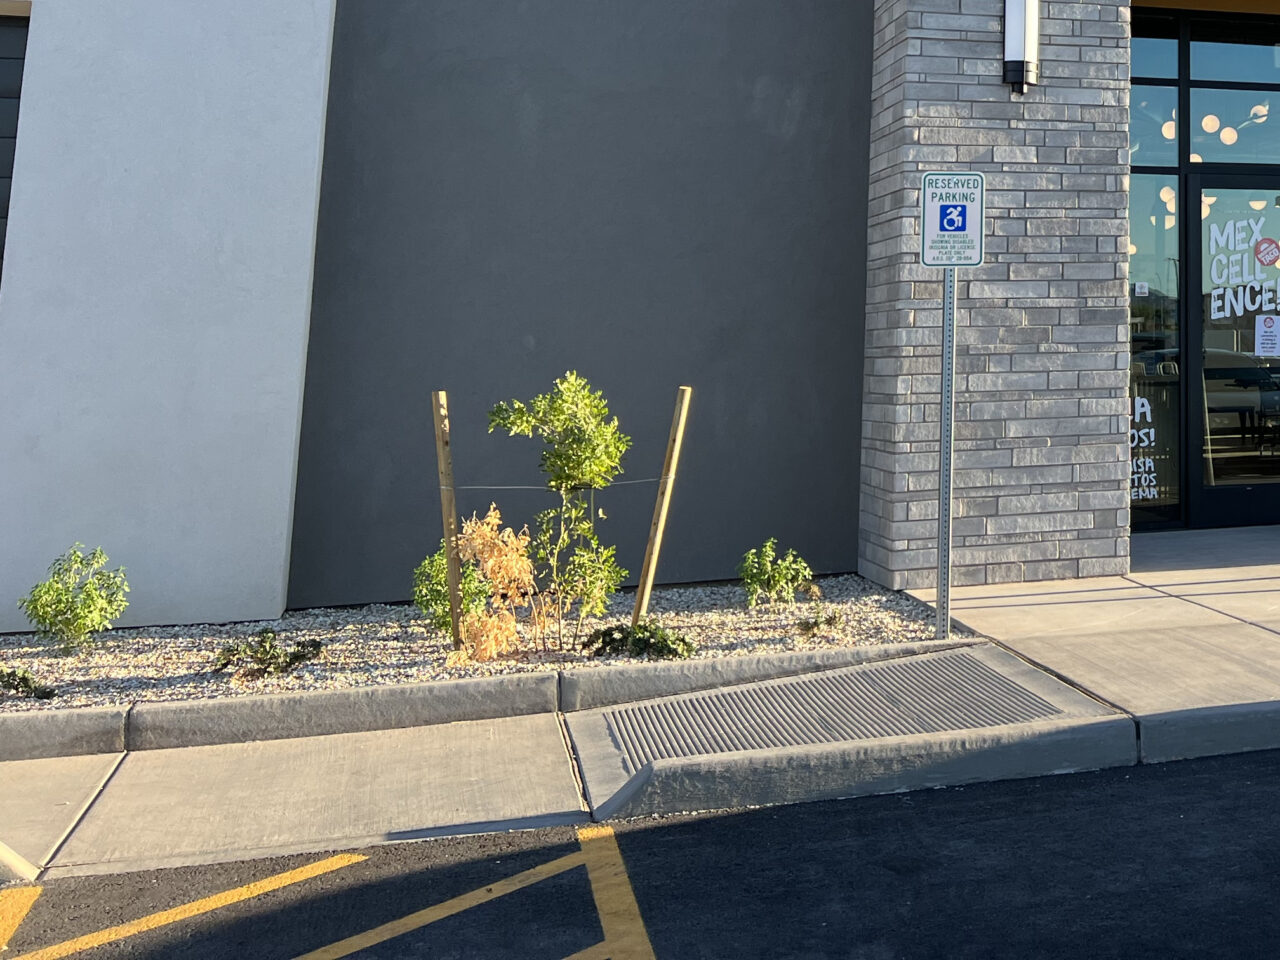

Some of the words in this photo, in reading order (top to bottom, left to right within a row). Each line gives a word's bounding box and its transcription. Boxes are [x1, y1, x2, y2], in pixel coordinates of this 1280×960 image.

[927, 178, 979, 189] RESERVED
[931, 192, 976, 203] PARKING
[1209, 216, 1266, 255] MEX
[1210, 253, 1267, 285] CELL
[1130, 458, 1155, 472] ISA
[1130, 473, 1157, 487] TOS
